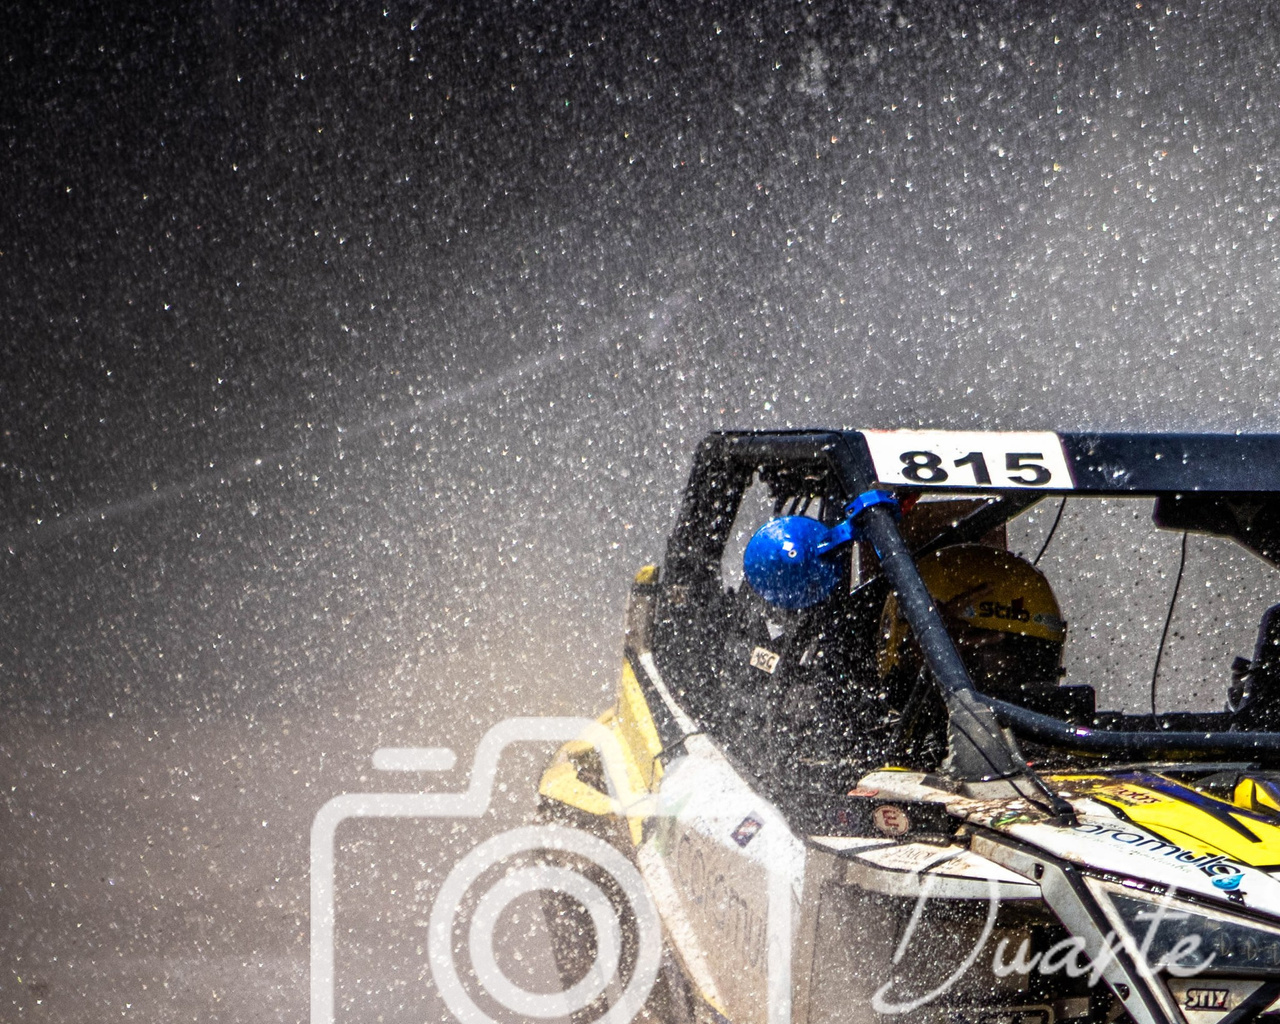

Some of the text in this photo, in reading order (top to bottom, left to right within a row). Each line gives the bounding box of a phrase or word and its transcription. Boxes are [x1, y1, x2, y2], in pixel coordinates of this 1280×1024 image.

[899, 451, 1052, 486] 815
[1070, 823, 1242, 878] aramulo
[1185, 989, 1228, 1010] STIX
